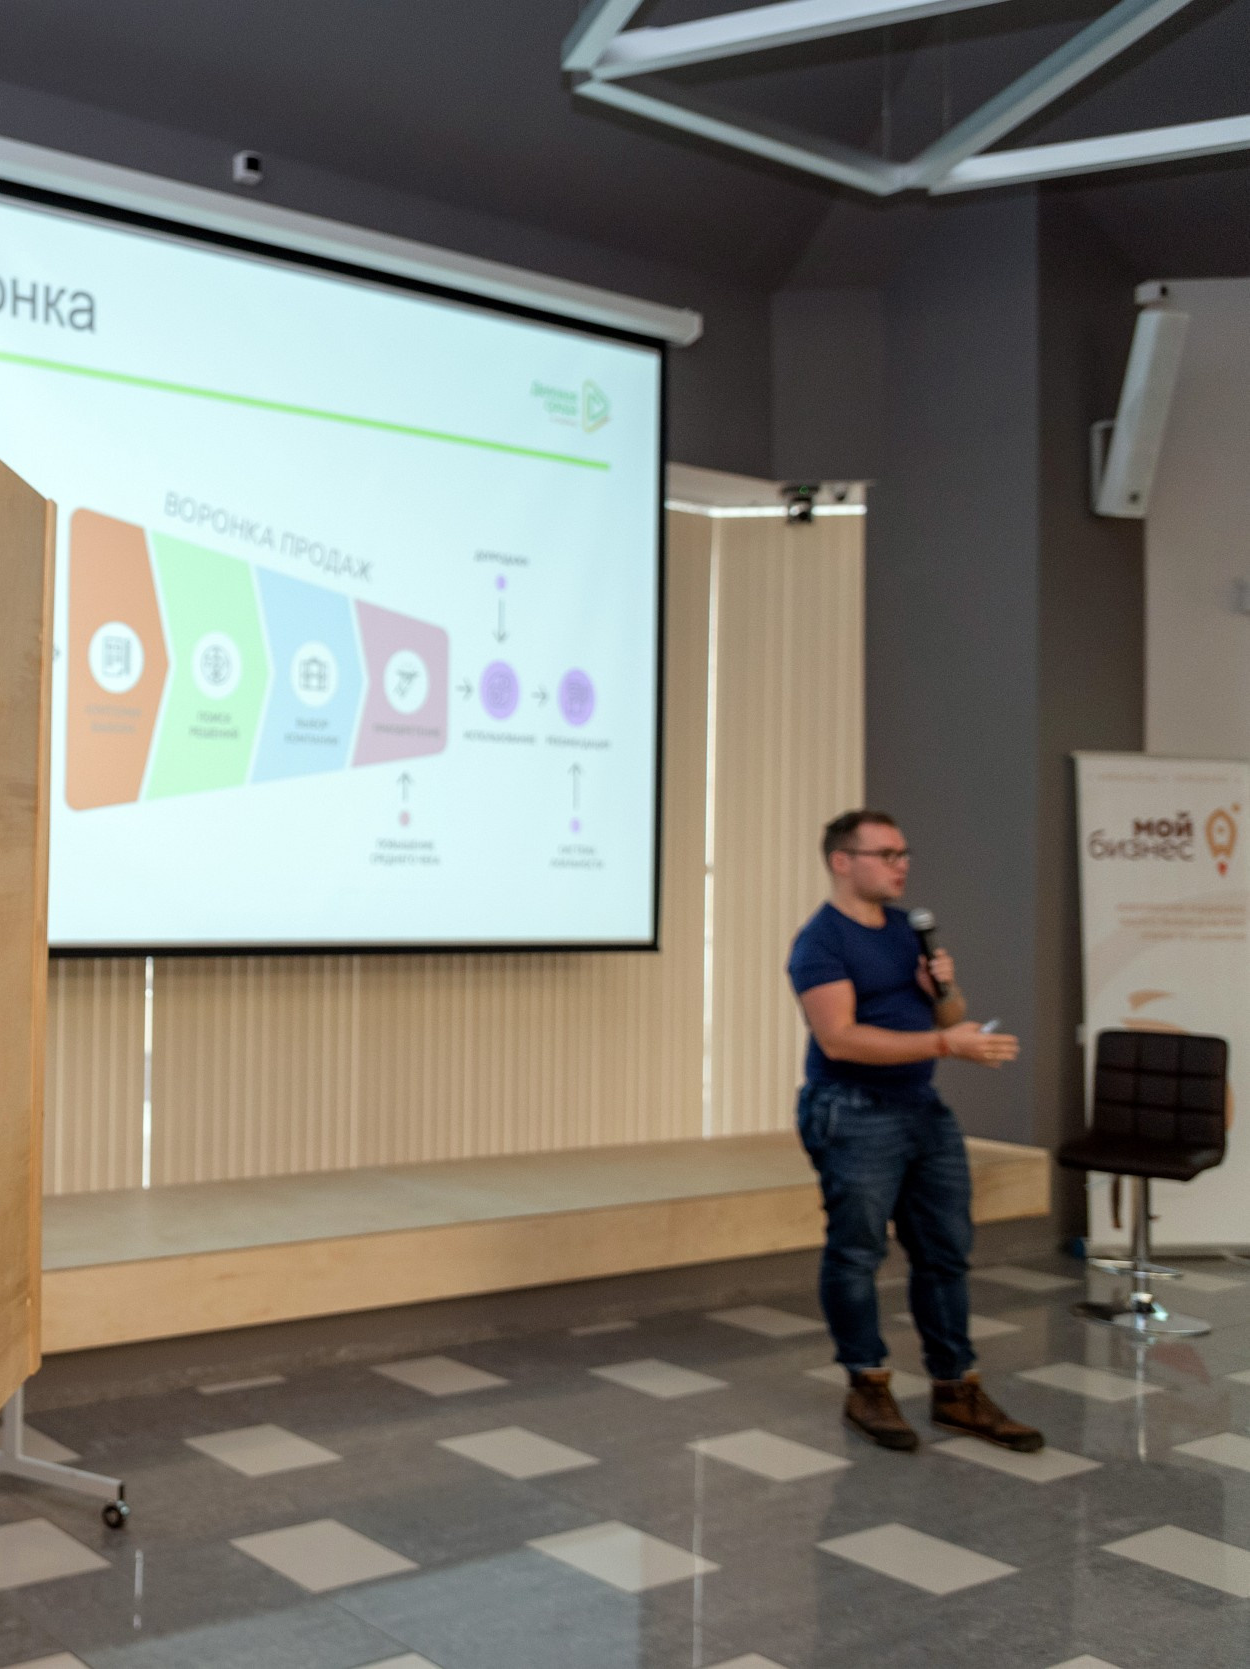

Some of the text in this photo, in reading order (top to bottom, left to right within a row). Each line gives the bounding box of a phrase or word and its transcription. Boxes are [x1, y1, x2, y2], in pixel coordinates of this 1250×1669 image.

[164, 490, 374, 582] ВОРОНКА ПРОДАЖ
[1087, 829, 1196, 862] бизнес
